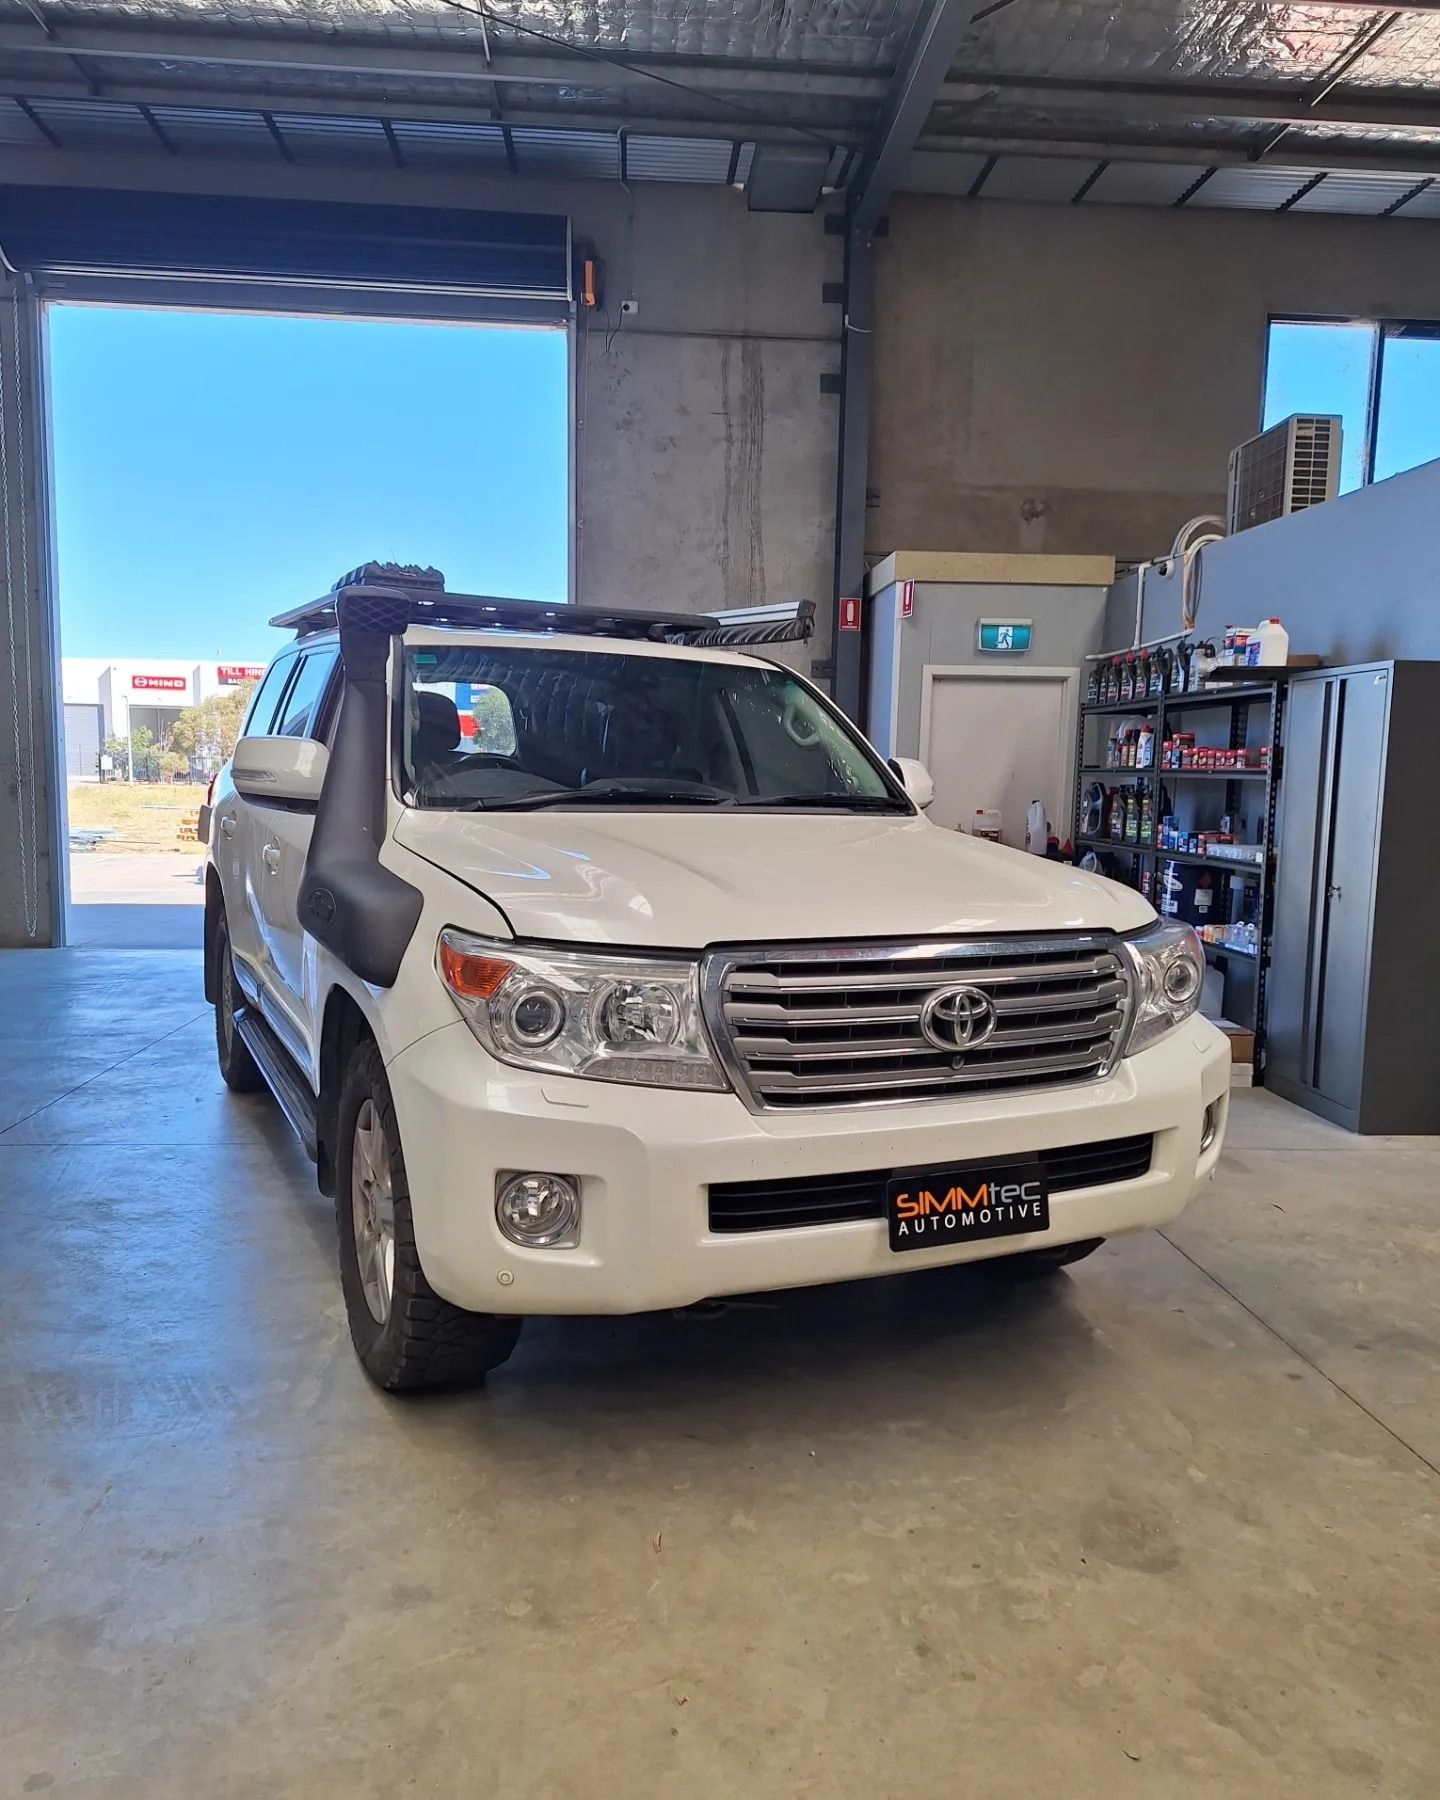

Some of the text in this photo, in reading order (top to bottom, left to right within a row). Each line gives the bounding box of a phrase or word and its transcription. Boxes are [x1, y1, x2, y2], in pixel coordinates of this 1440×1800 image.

[148, 678, 184, 688] HINO
[896, 1181, 1042, 1219] SIMMtec
[898, 1201, 1042, 1237] AUTOMOTIVE
